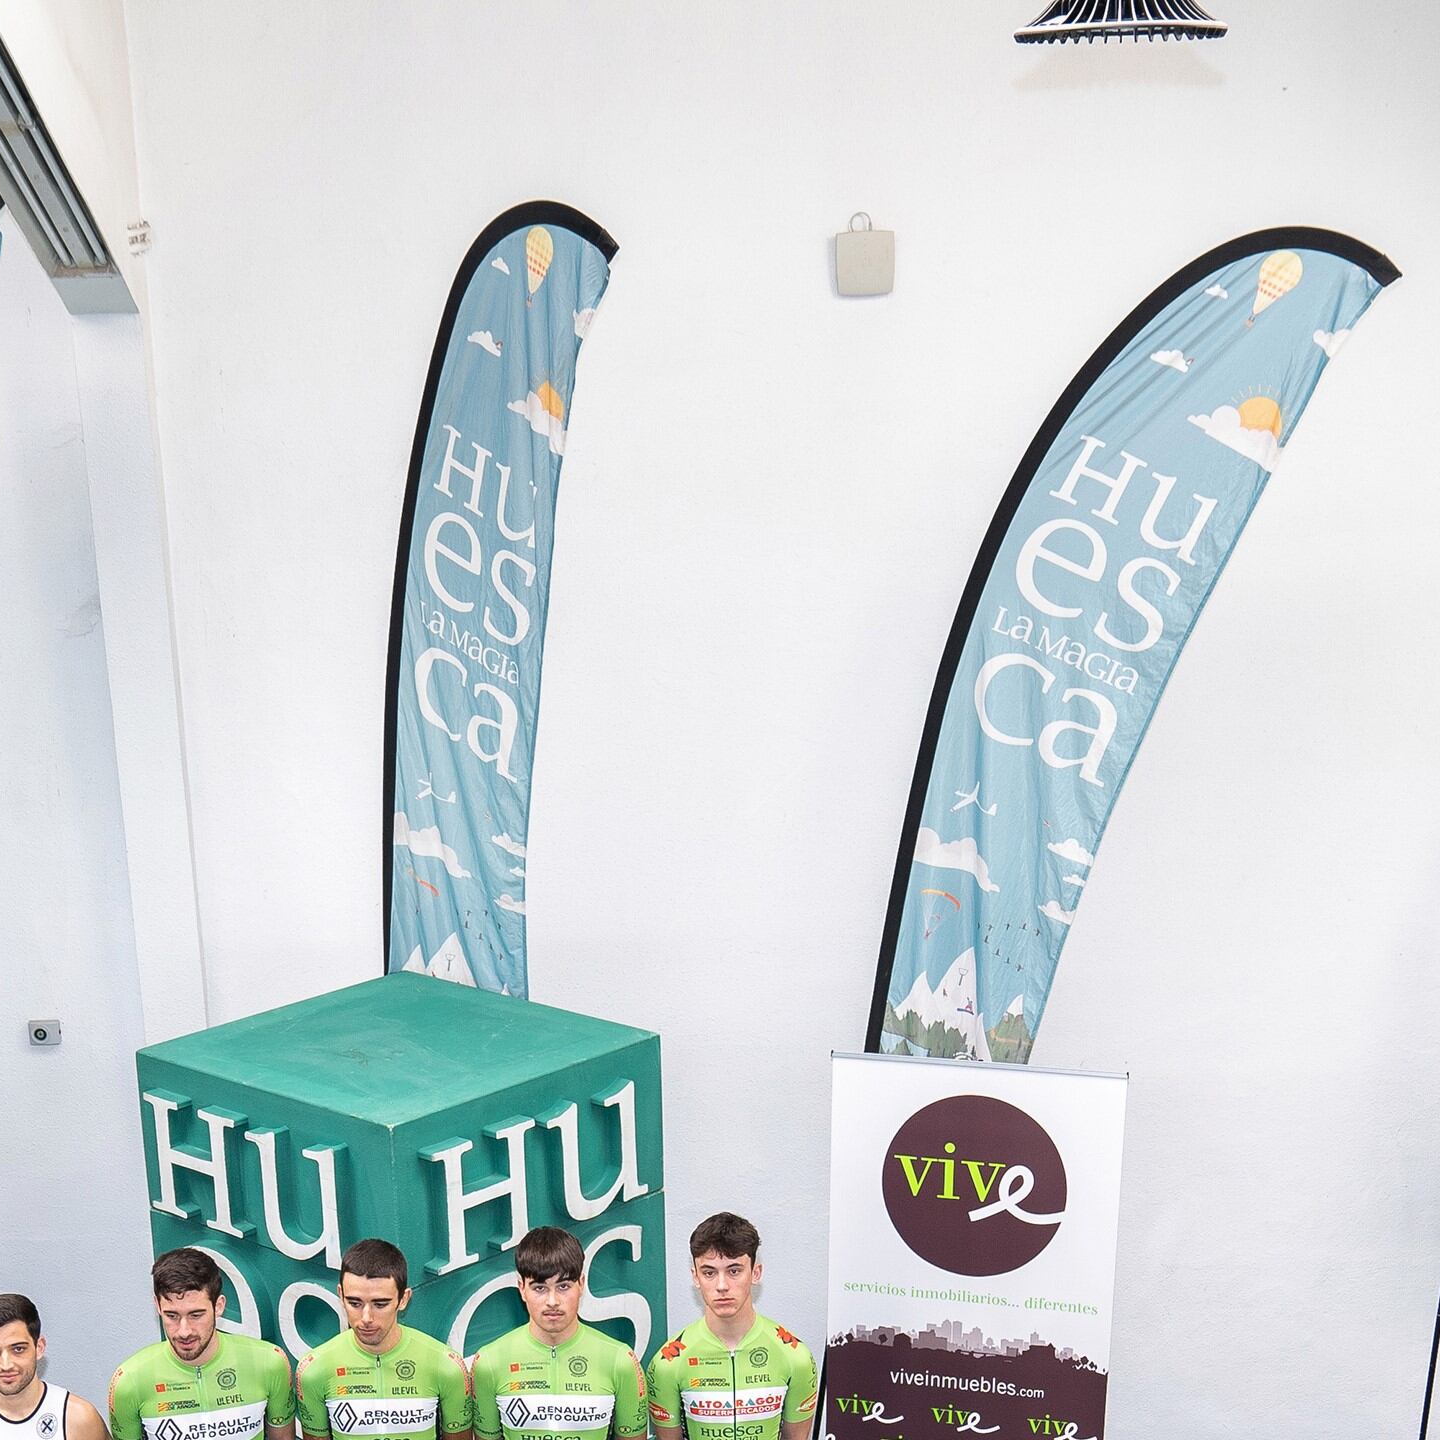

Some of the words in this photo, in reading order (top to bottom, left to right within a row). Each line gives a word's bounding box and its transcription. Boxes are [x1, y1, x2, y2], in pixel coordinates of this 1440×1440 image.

[423, 510, 536, 647] es
[1014, 516, 1182, 653] es
[894, 1141, 1066, 1225] vive
[843, 1279, 907, 1298] servicios
[1023, 1297, 1099, 1317] diferentes
[889, 1368, 1045, 1400] viveinmuebles.com
[188, 1415, 252, 1433] RENAULT
[364, 1408, 425, 1419] RENAULT
[537, 1405, 599, 1416] RENAULT
[697, 1404, 777, 1417] SUPERMERCADOS
[835, 1392, 905, 1424] vive
[931, 1403, 1001, 1435] vive
[700, 1424, 765, 1439] Huesca
